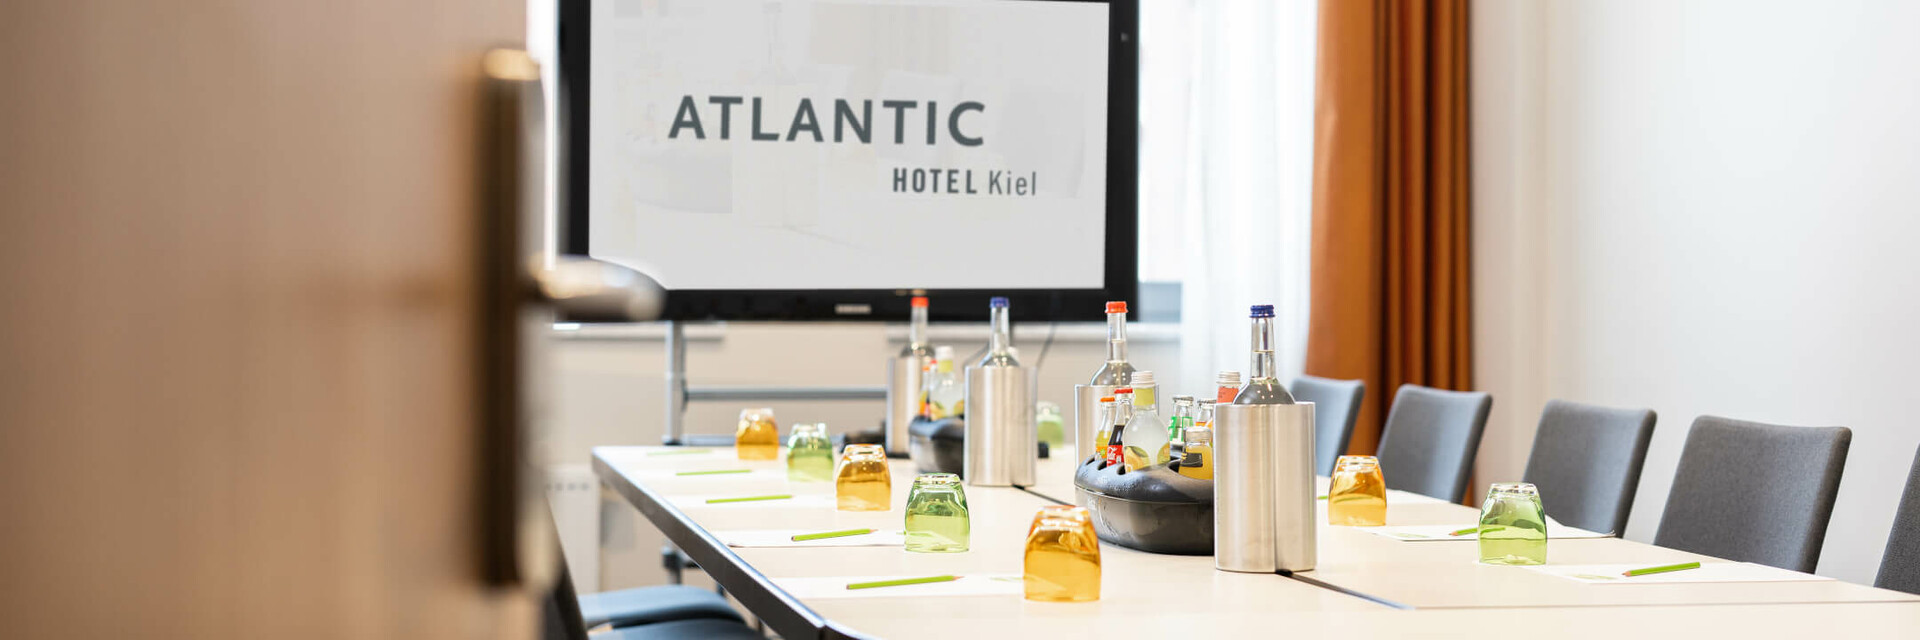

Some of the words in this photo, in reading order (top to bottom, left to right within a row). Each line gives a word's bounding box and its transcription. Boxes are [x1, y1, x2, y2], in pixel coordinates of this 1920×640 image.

[668, 95, 985, 146] ATLANTIC
[893, 168, 977, 195] HOTEL
[988, 170, 1037, 196] Kiel
